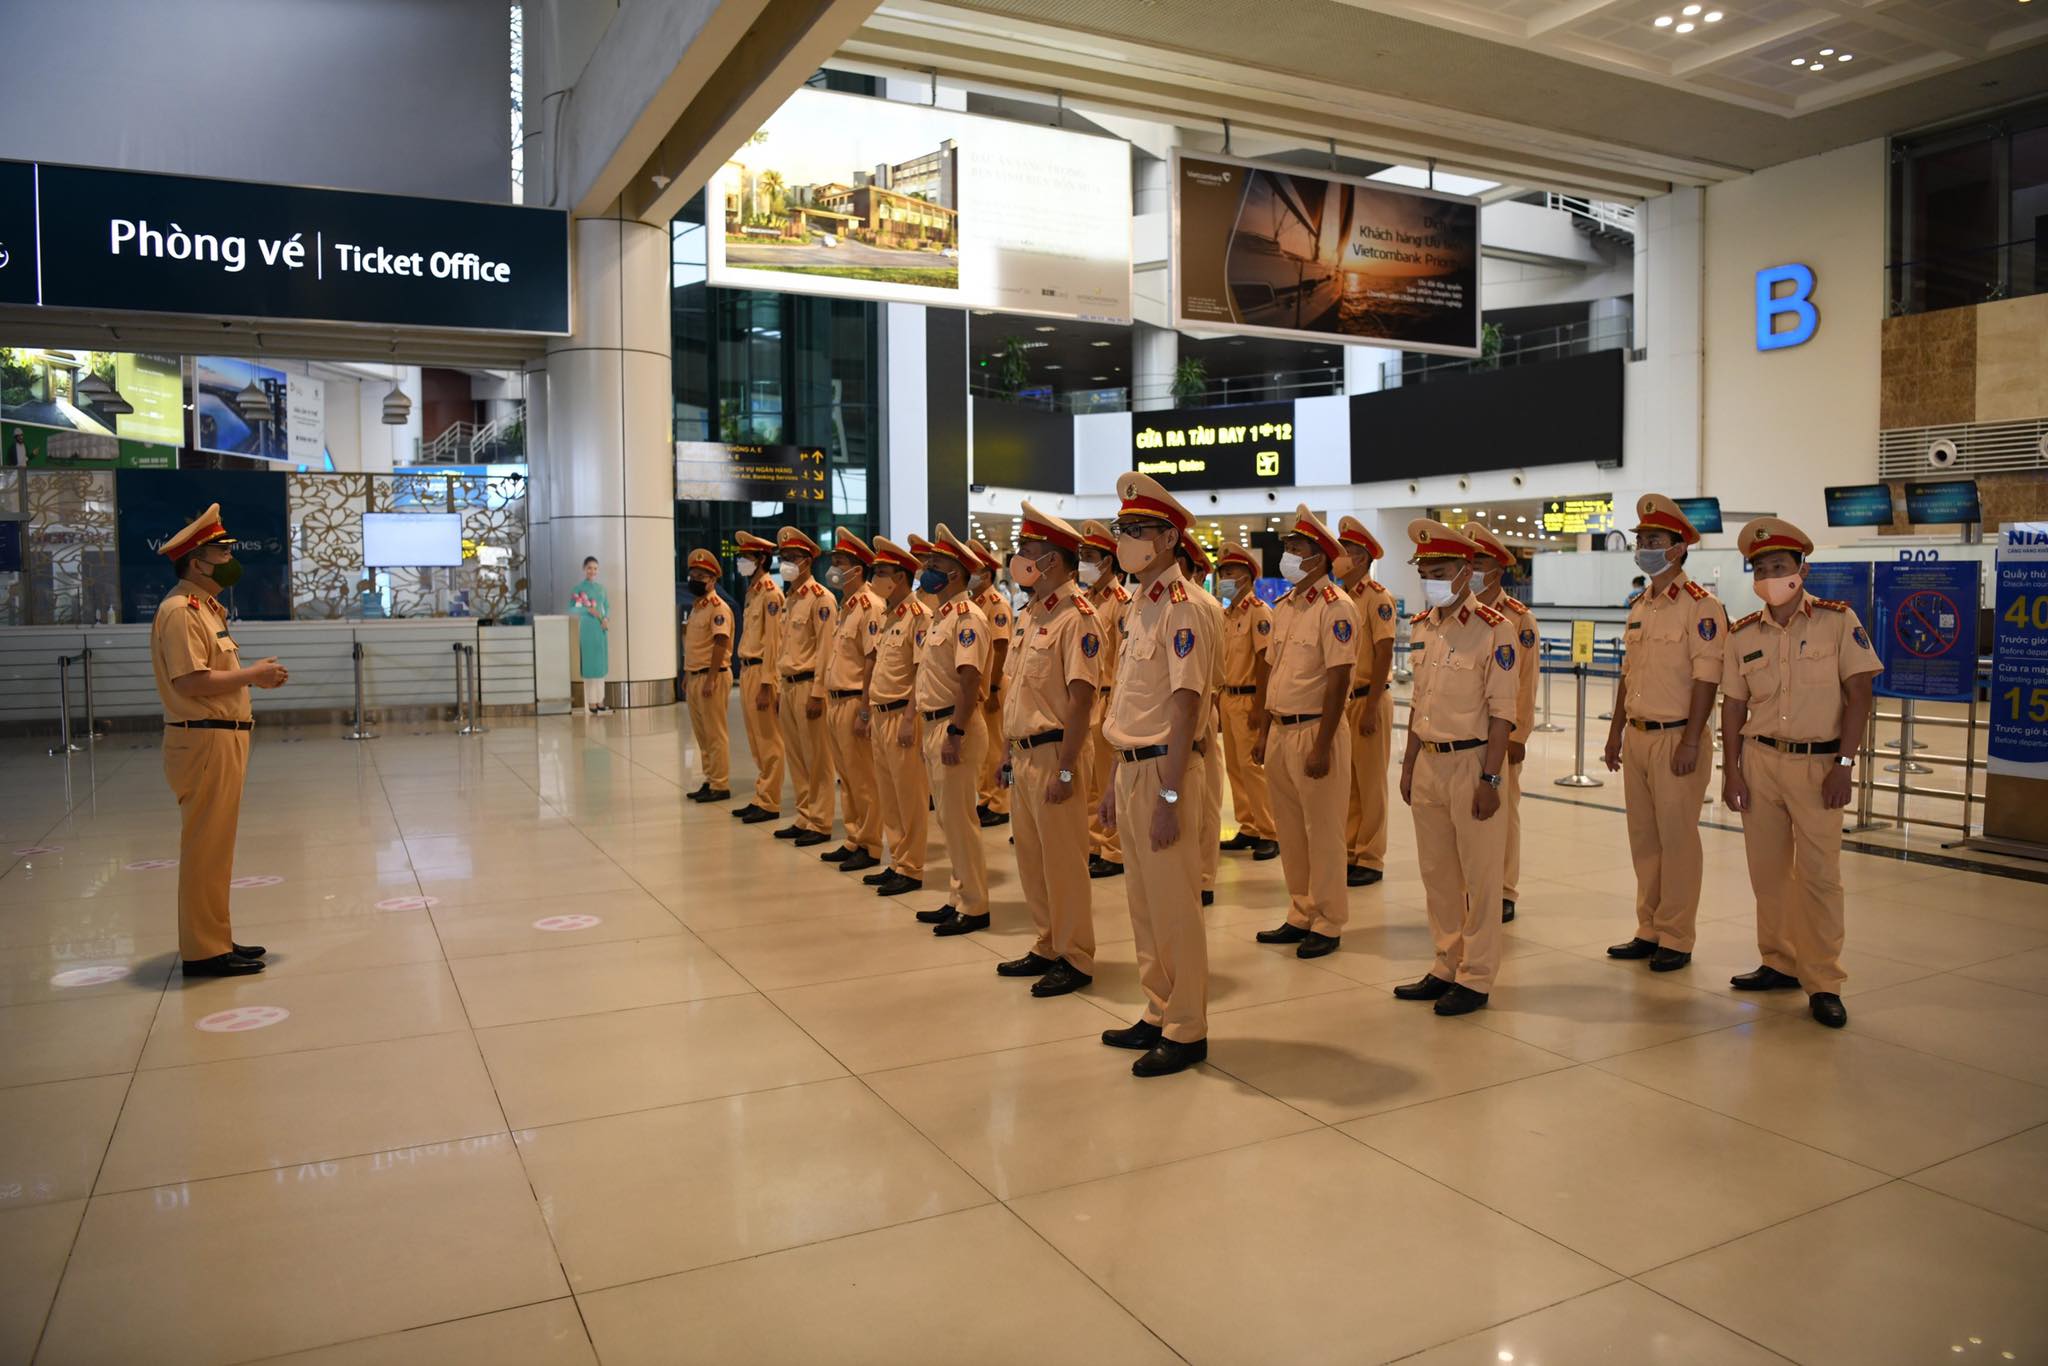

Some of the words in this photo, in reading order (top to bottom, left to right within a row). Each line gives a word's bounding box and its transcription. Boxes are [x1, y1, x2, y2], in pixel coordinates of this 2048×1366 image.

[111, 218, 246, 272] Phòng
[258, 233, 306, 268] vé
[1359, 225, 1393, 241] Khách
[1396, 231, 1422, 248] hàng
[335, 243, 423, 277] Ticket
[430, 251, 511, 283] Office
[1352, 243, 1422, 265] Vietcombank
[1756, 263, 1819, 352] B
[1136, 427, 1163, 449] CỬA
[1166, 430, 1186, 447] RA
[1188, 426, 1215, 446] TÀU
[1218, 426, 1246, 444] BAY
[2003, 568, 2028, 580] Quầy
[2030, 568, 2047, 579] thủ
[2004, 594, 2048, 630] 40
[2000, 634, 2028, 645] Trước
[2000, 646, 2024, 655] Before
[1999, 663, 2018, 673] Cửa
[2020, 665, 2029, 673] ra
[2003, 687, 2048, 722] 15
[1995, 724, 2023, 734] Trước
